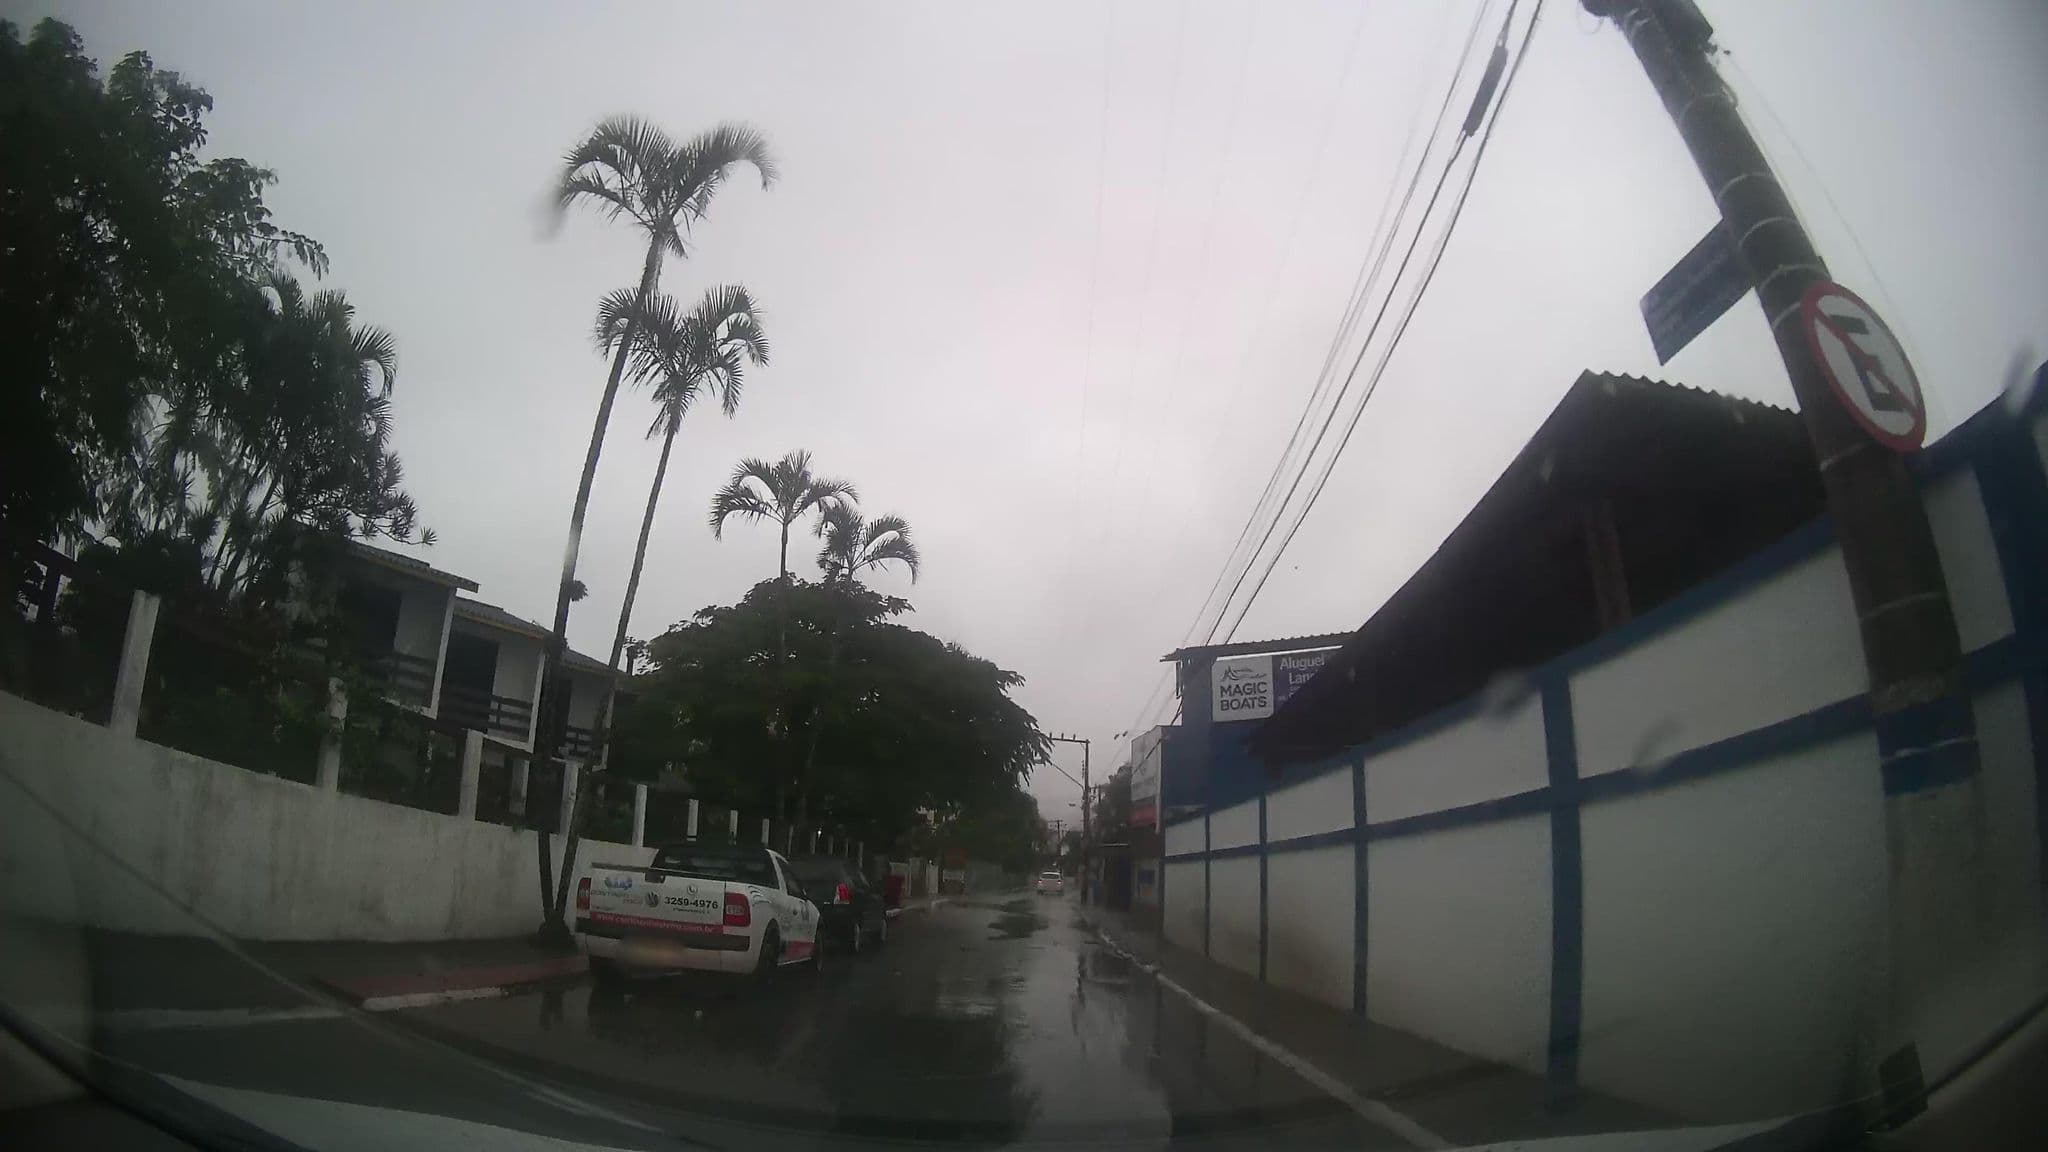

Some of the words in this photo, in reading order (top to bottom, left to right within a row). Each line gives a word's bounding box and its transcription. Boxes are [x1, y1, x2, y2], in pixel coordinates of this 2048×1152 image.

[1280, 653, 1325, 671] Aluguel
[1220, 681, 1267, 697] MAGIC
[1220, 696, 1267, 711] BOATS
[664, 896, 719, 909] 3259-4976
